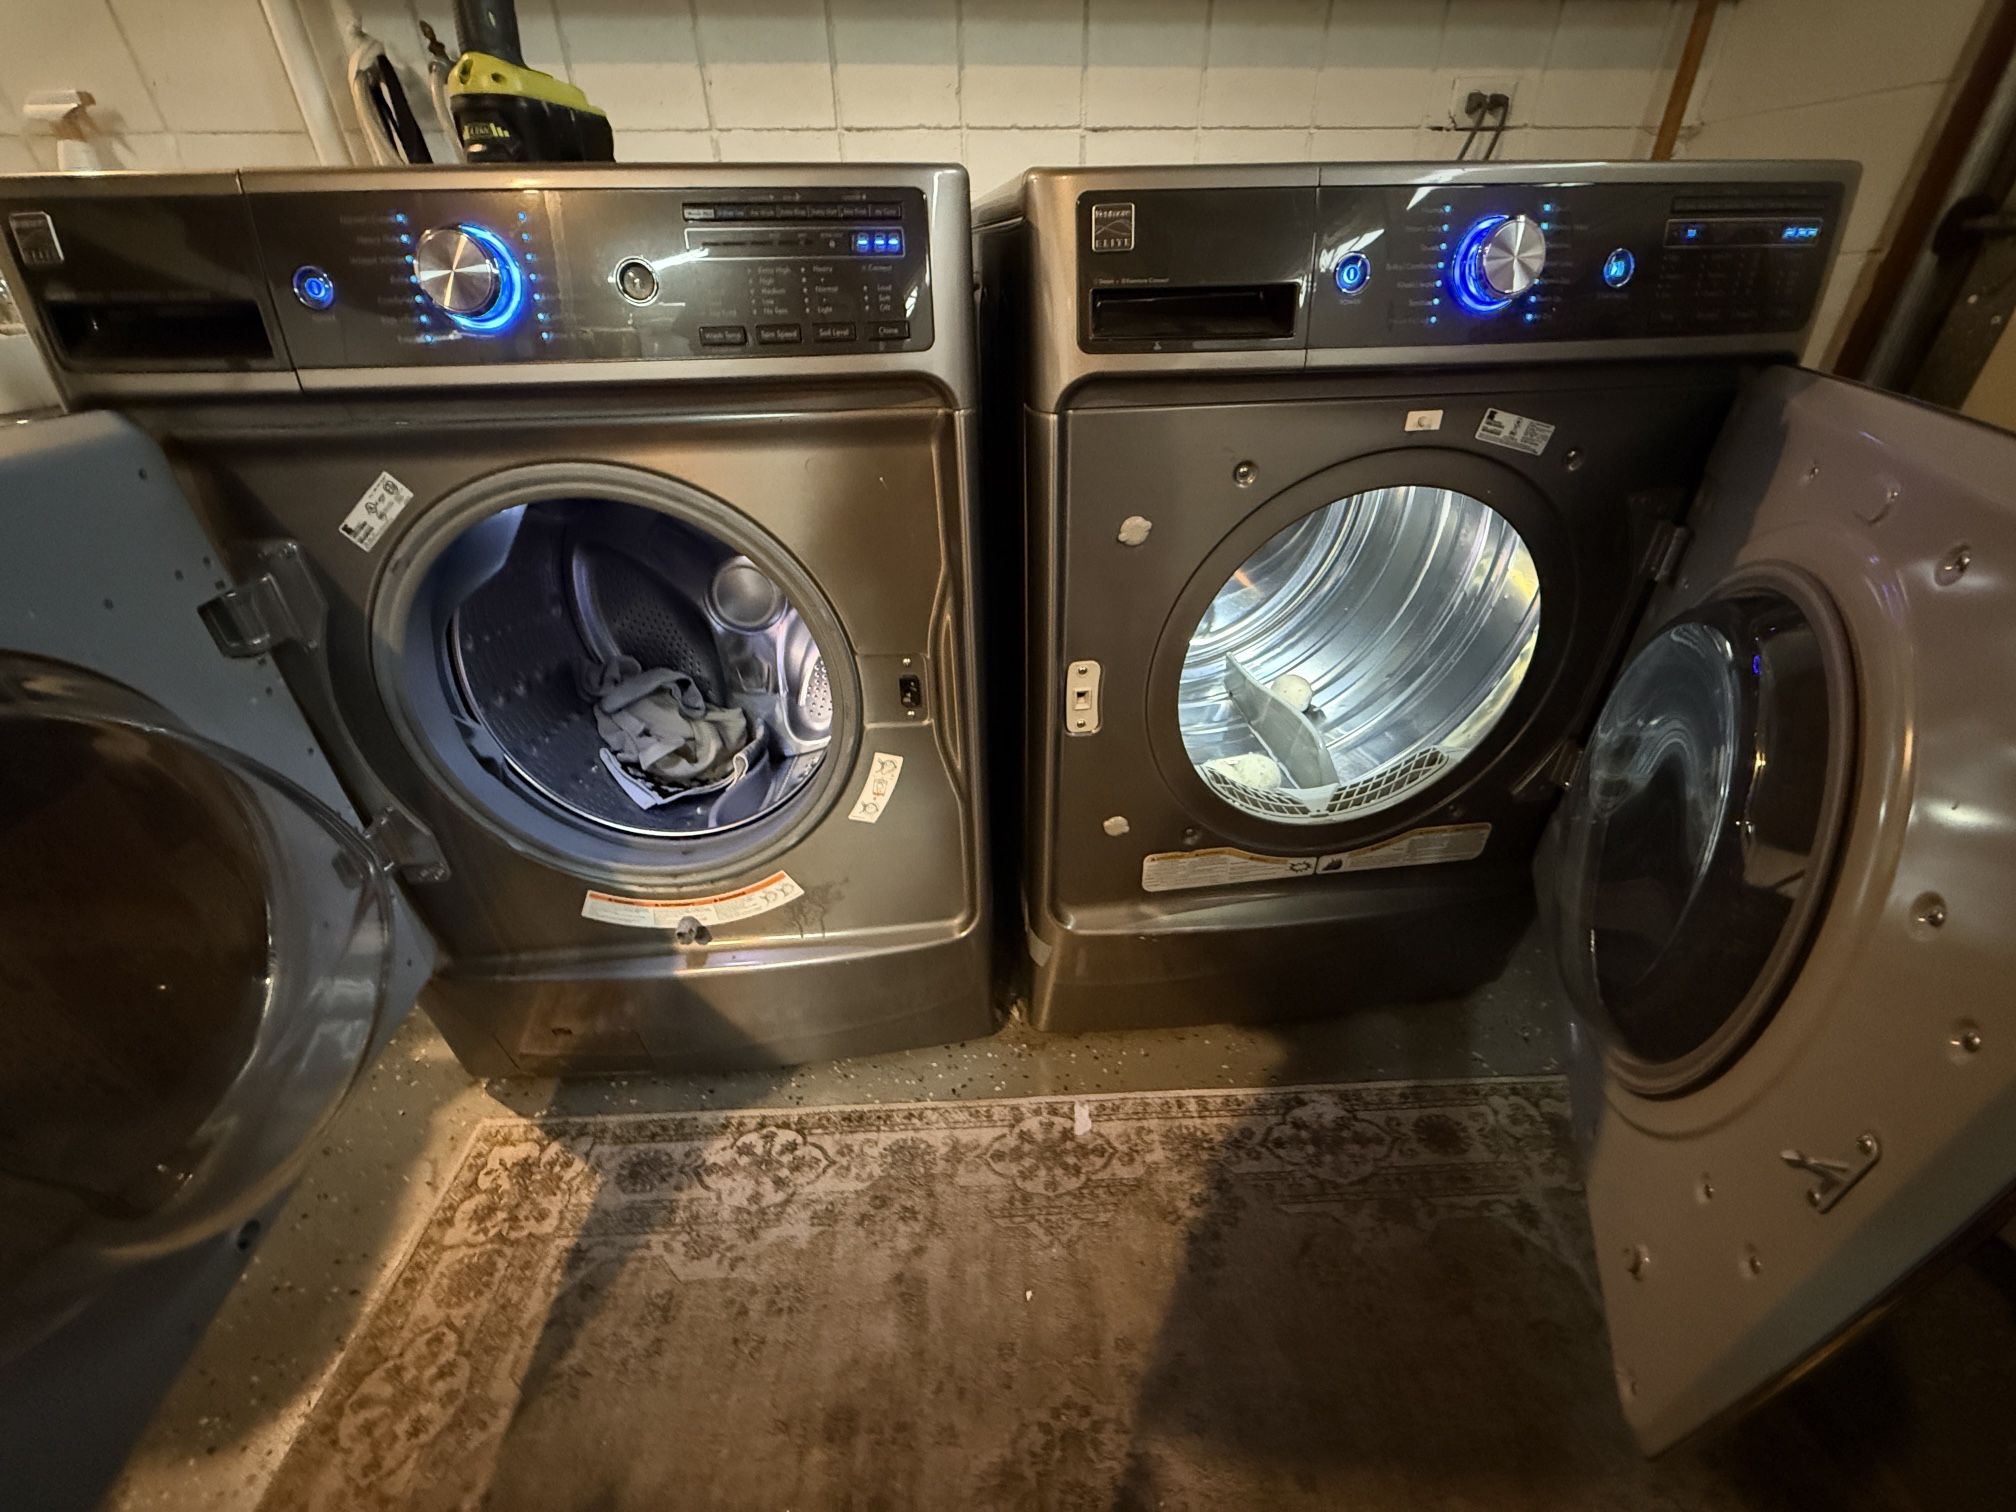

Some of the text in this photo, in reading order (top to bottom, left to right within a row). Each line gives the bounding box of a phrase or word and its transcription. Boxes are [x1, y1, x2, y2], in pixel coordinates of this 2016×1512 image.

[1095, 239, 1130, 248] ELITE
[762, 287, 786, 295] Medium
[815, 285, 839, 293] Normal
[817, 305, 833, 315] Light
[760, 328, 797, 339] Spin Speed
[818, 327, 850, 337] Soil Level
